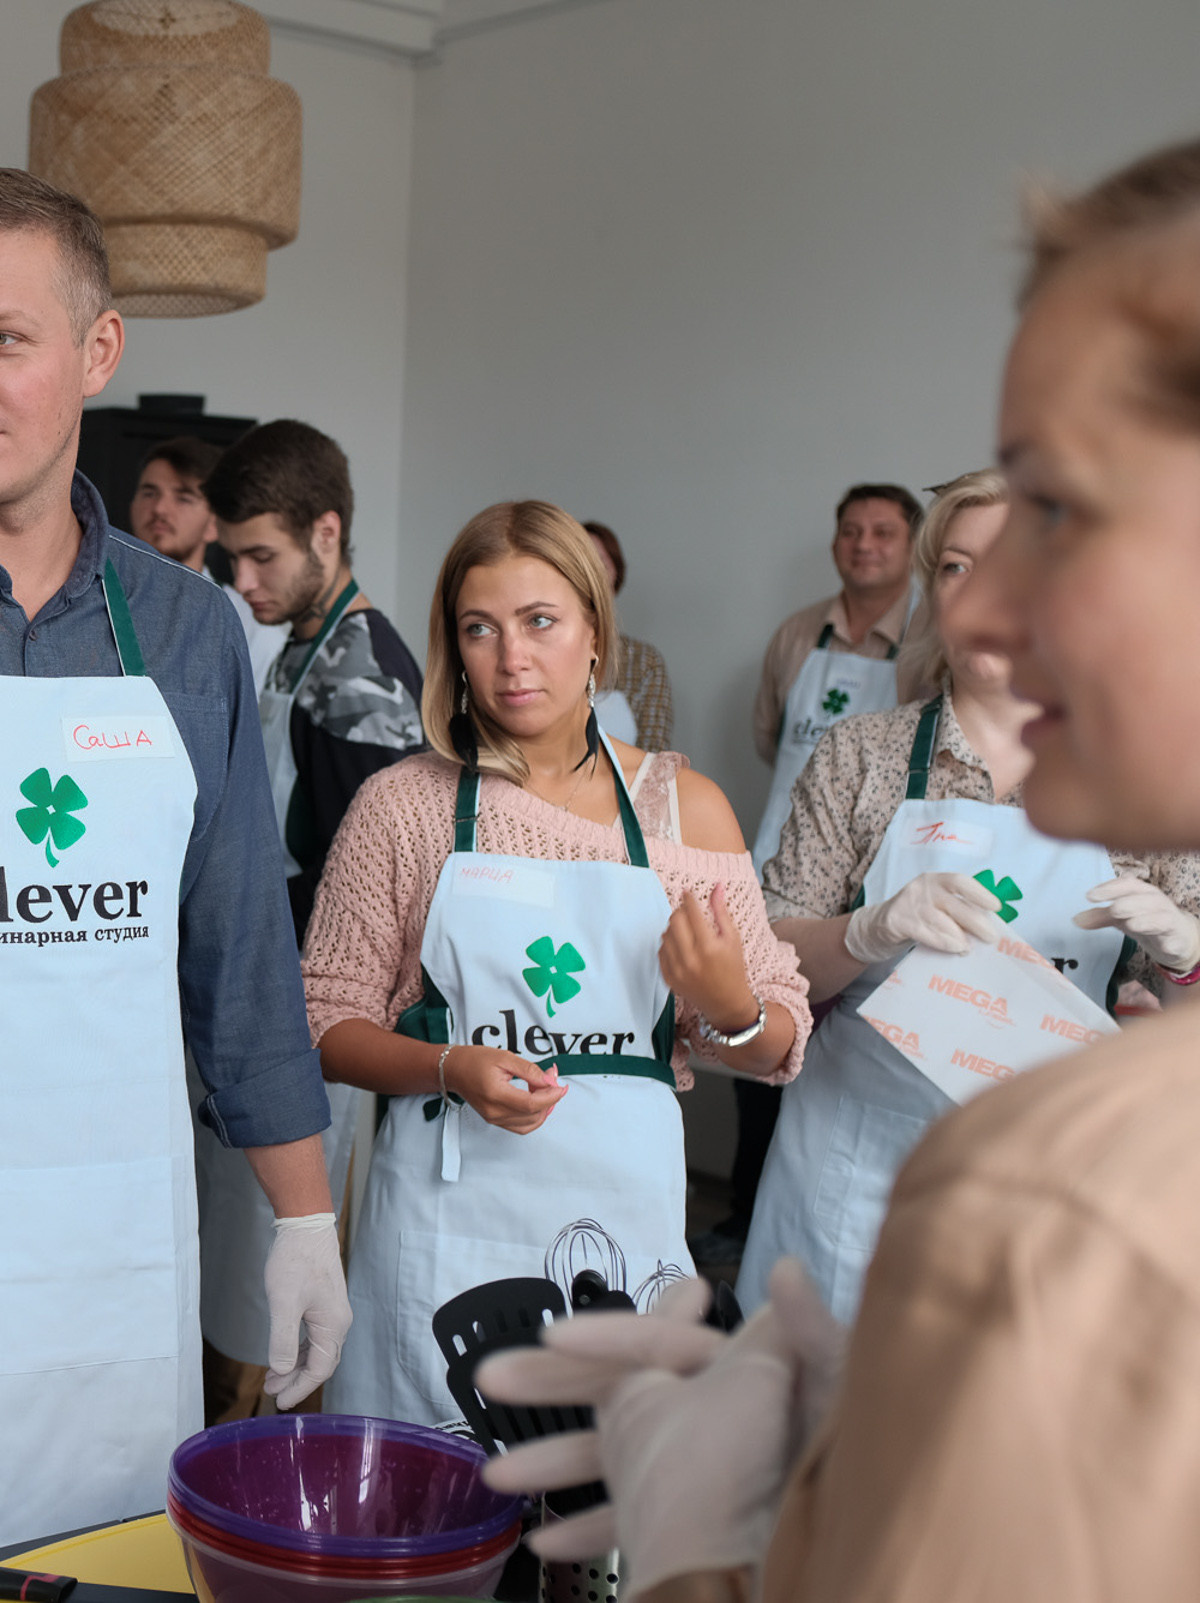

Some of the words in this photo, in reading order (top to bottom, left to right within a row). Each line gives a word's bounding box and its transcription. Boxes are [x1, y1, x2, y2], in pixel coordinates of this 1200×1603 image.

[94, 925, 150, 942] студия
[927, 974, 1009, 1017] MEGA
[862, 1014, 920, 1051] EGA
